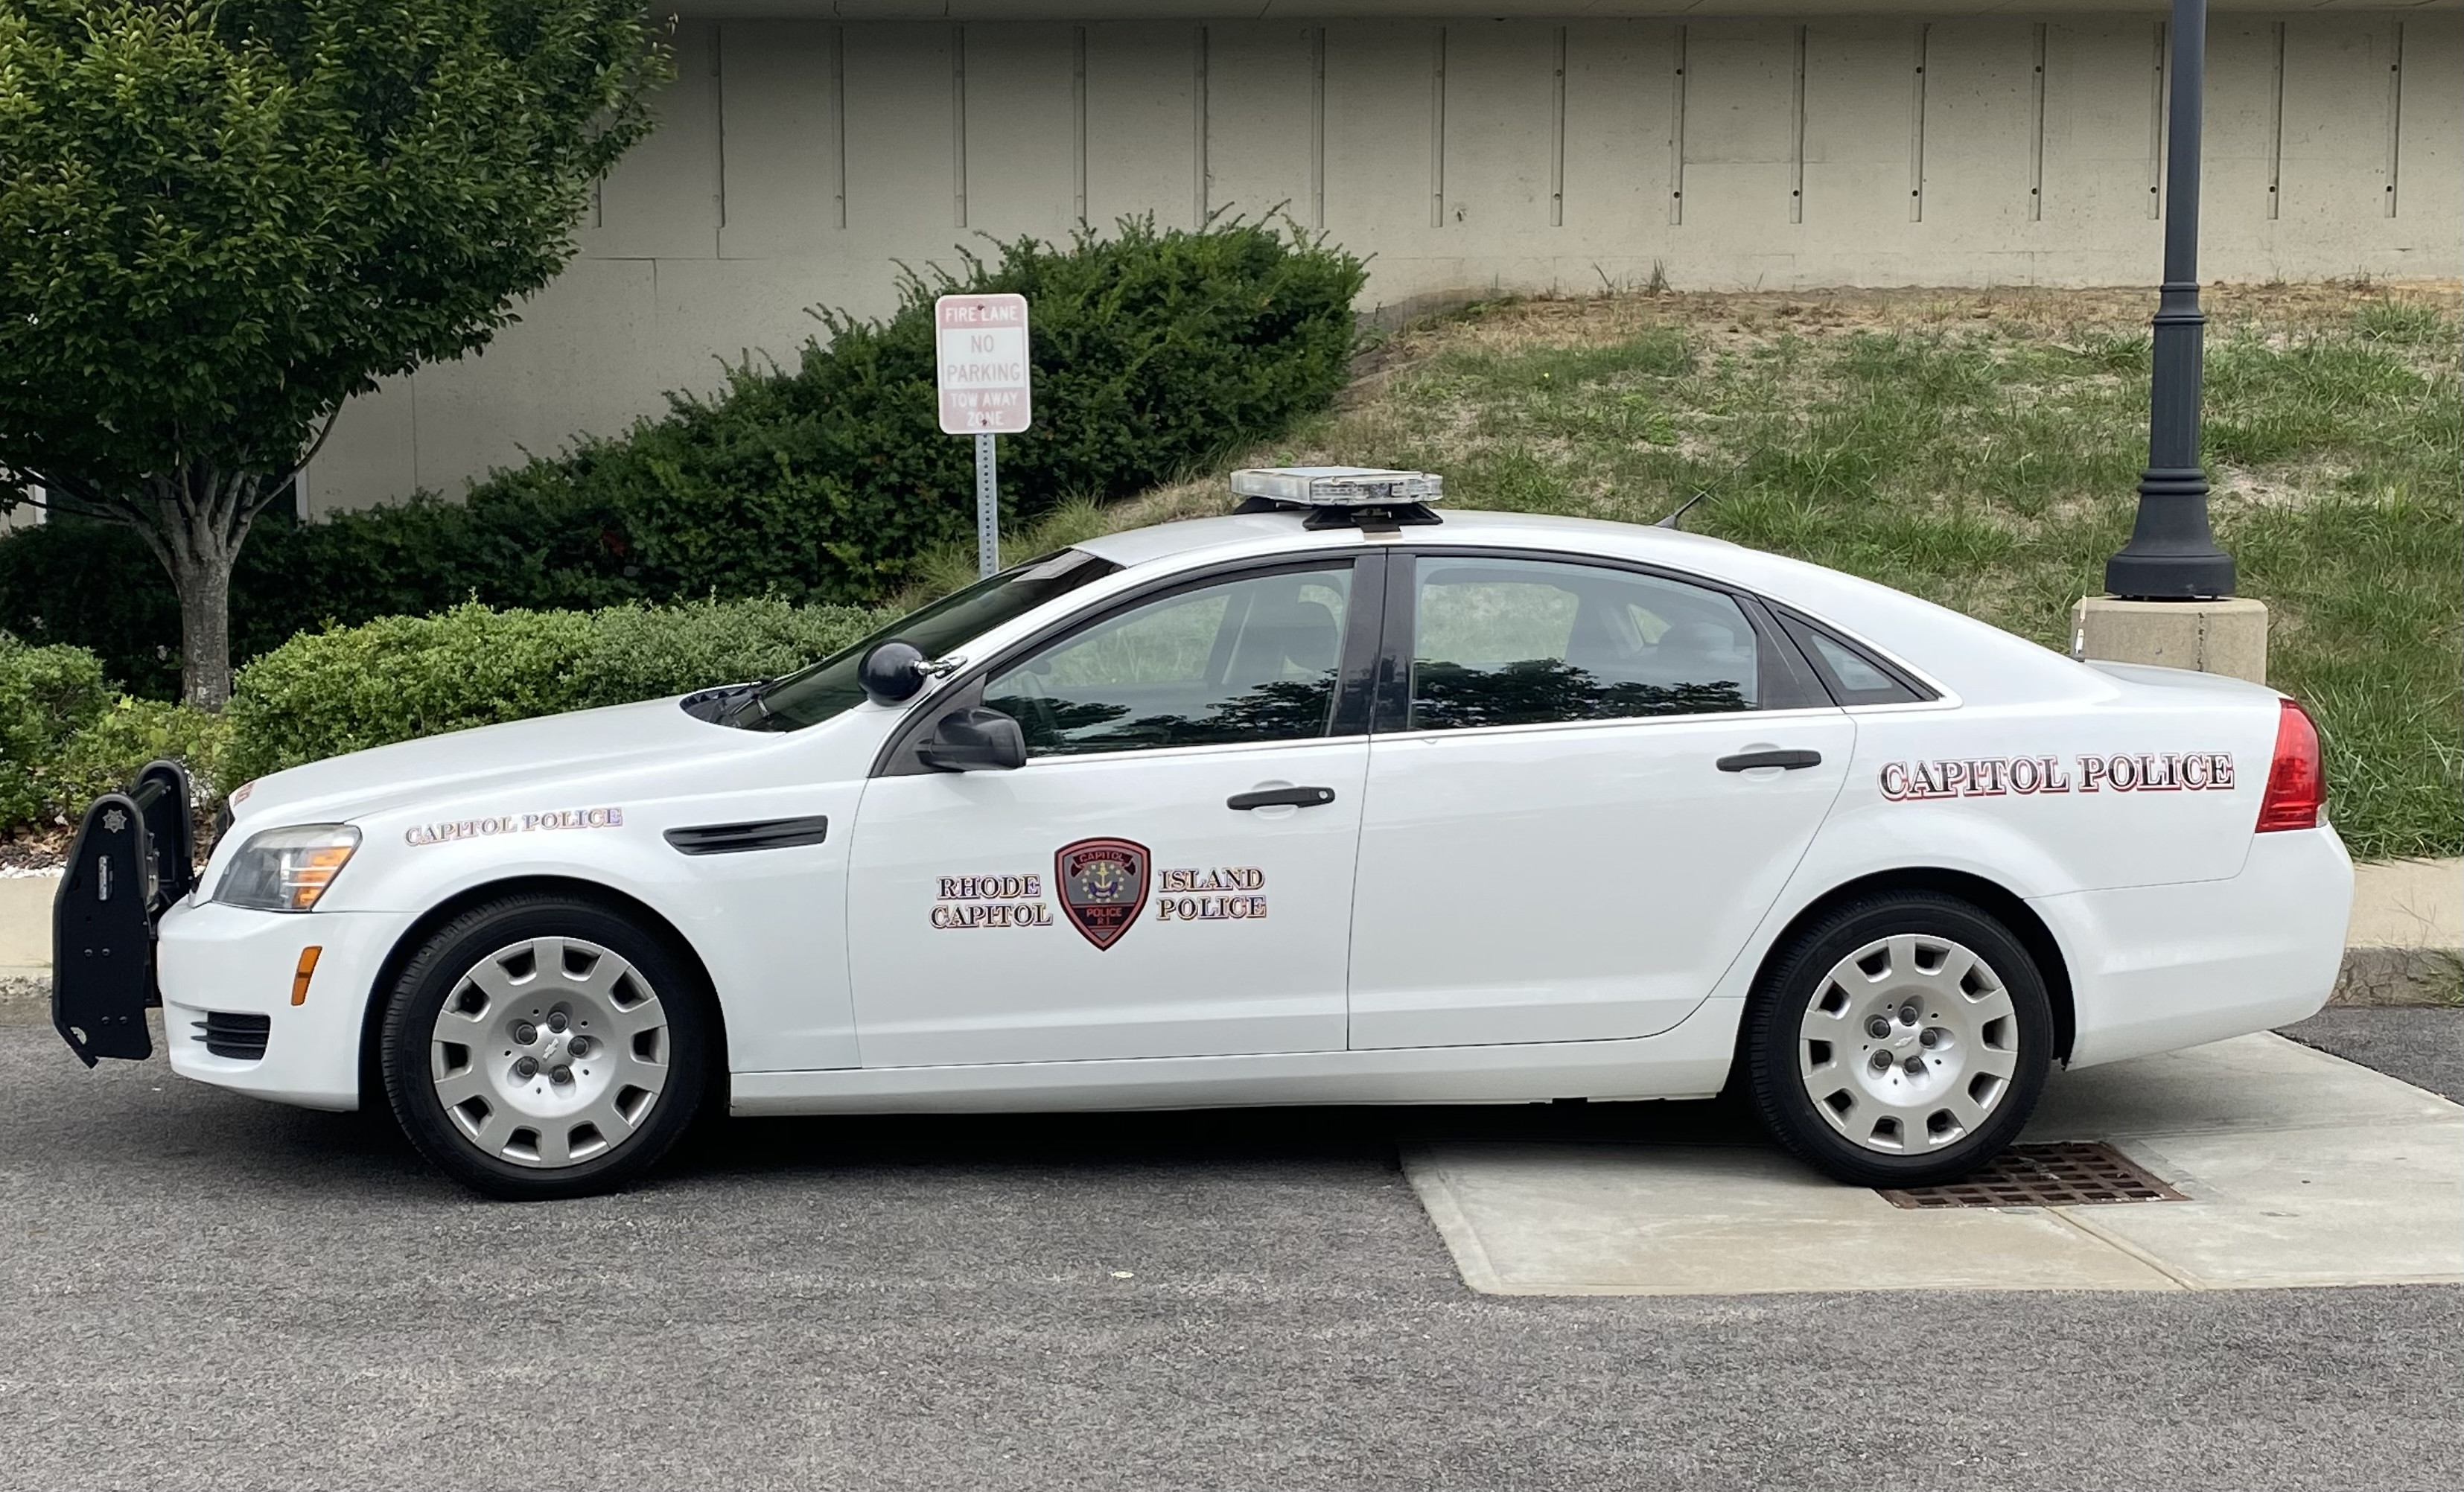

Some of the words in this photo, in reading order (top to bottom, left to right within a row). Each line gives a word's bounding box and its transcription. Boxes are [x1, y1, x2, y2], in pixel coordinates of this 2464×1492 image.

[945, 307, 977, 322] FIRE
[981, 305, 1018, 322] LANE
[971, 334, 994, 353] NO
[947, 363, 1020, 382] PARKING
[950, 392, 977, 407] TOW
[982, 391, 1018, 407] AWAY
[967, 411, 1005, 427] ZONE
[1877, 754, 2071, 802] CAPITOL
[2077, 751, 2235, 794] POLICE
[404, 816, 518, 847] CAPITOL
[522, 806, 623, 832] POLICE
[1079, 851, 1124, 863] CAPITOL
[936, 874, 1042, 900] RHODE
[1158, 866, 1265, 892] ISLAND
[929, 902, 1054, 929] CAPITOL
[1156, 895, 1267, 920] POLICE
[1086, 908, 1122, 917] POLICE
